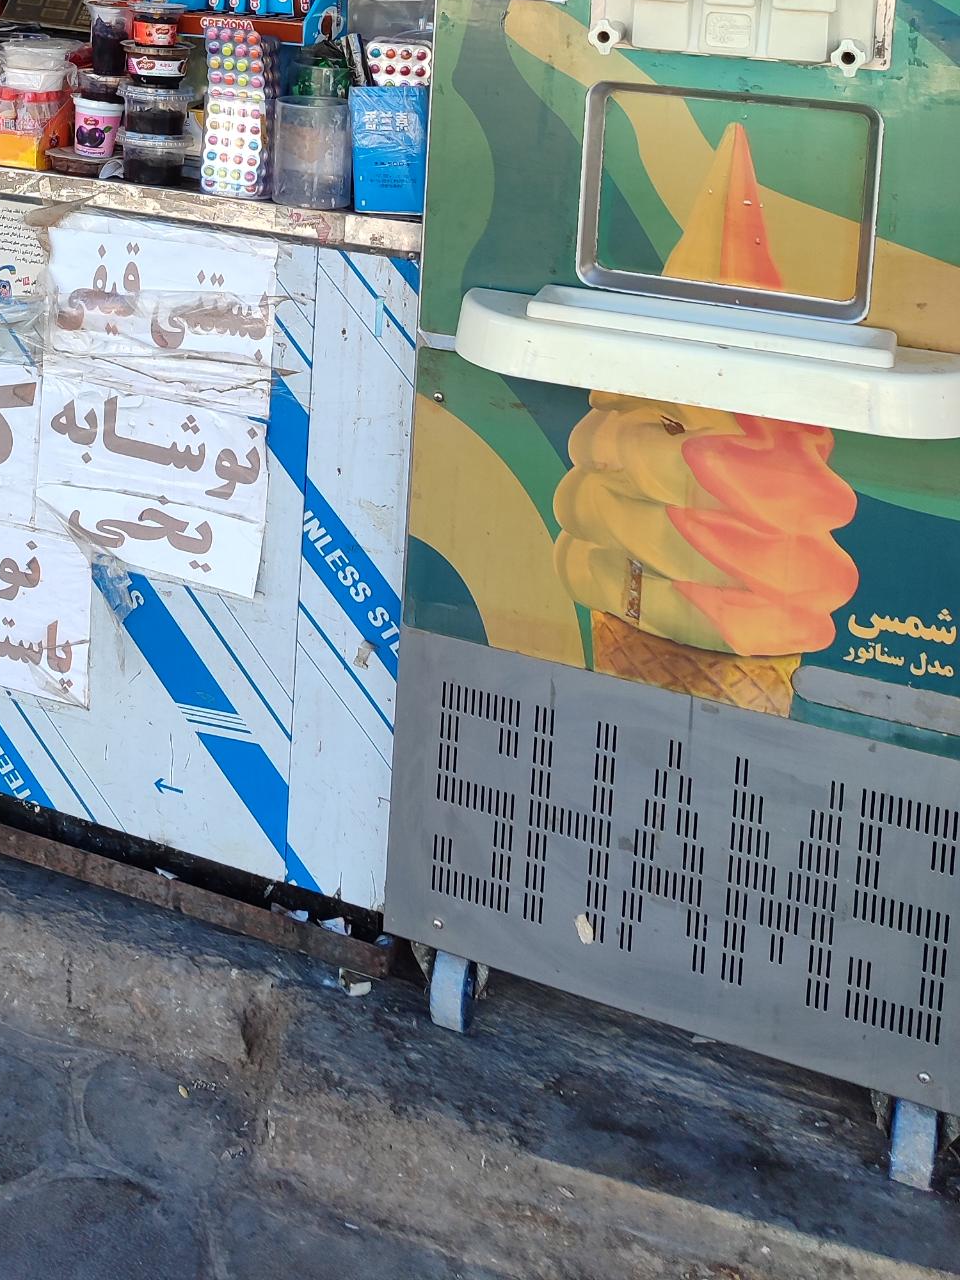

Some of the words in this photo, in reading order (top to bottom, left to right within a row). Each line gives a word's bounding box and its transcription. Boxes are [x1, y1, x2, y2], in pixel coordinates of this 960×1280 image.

[56, 242, 143, 338] قیفی
[151, 269, 270, 364] بستنی
[50, 395, 261, 500] نوشابه
[67, 494, 216, 573] یخی
[842, 642, 905, 668] سناتور
[848, 608, 957, 645] شمس
[909, 652, 955, 678] مدل
